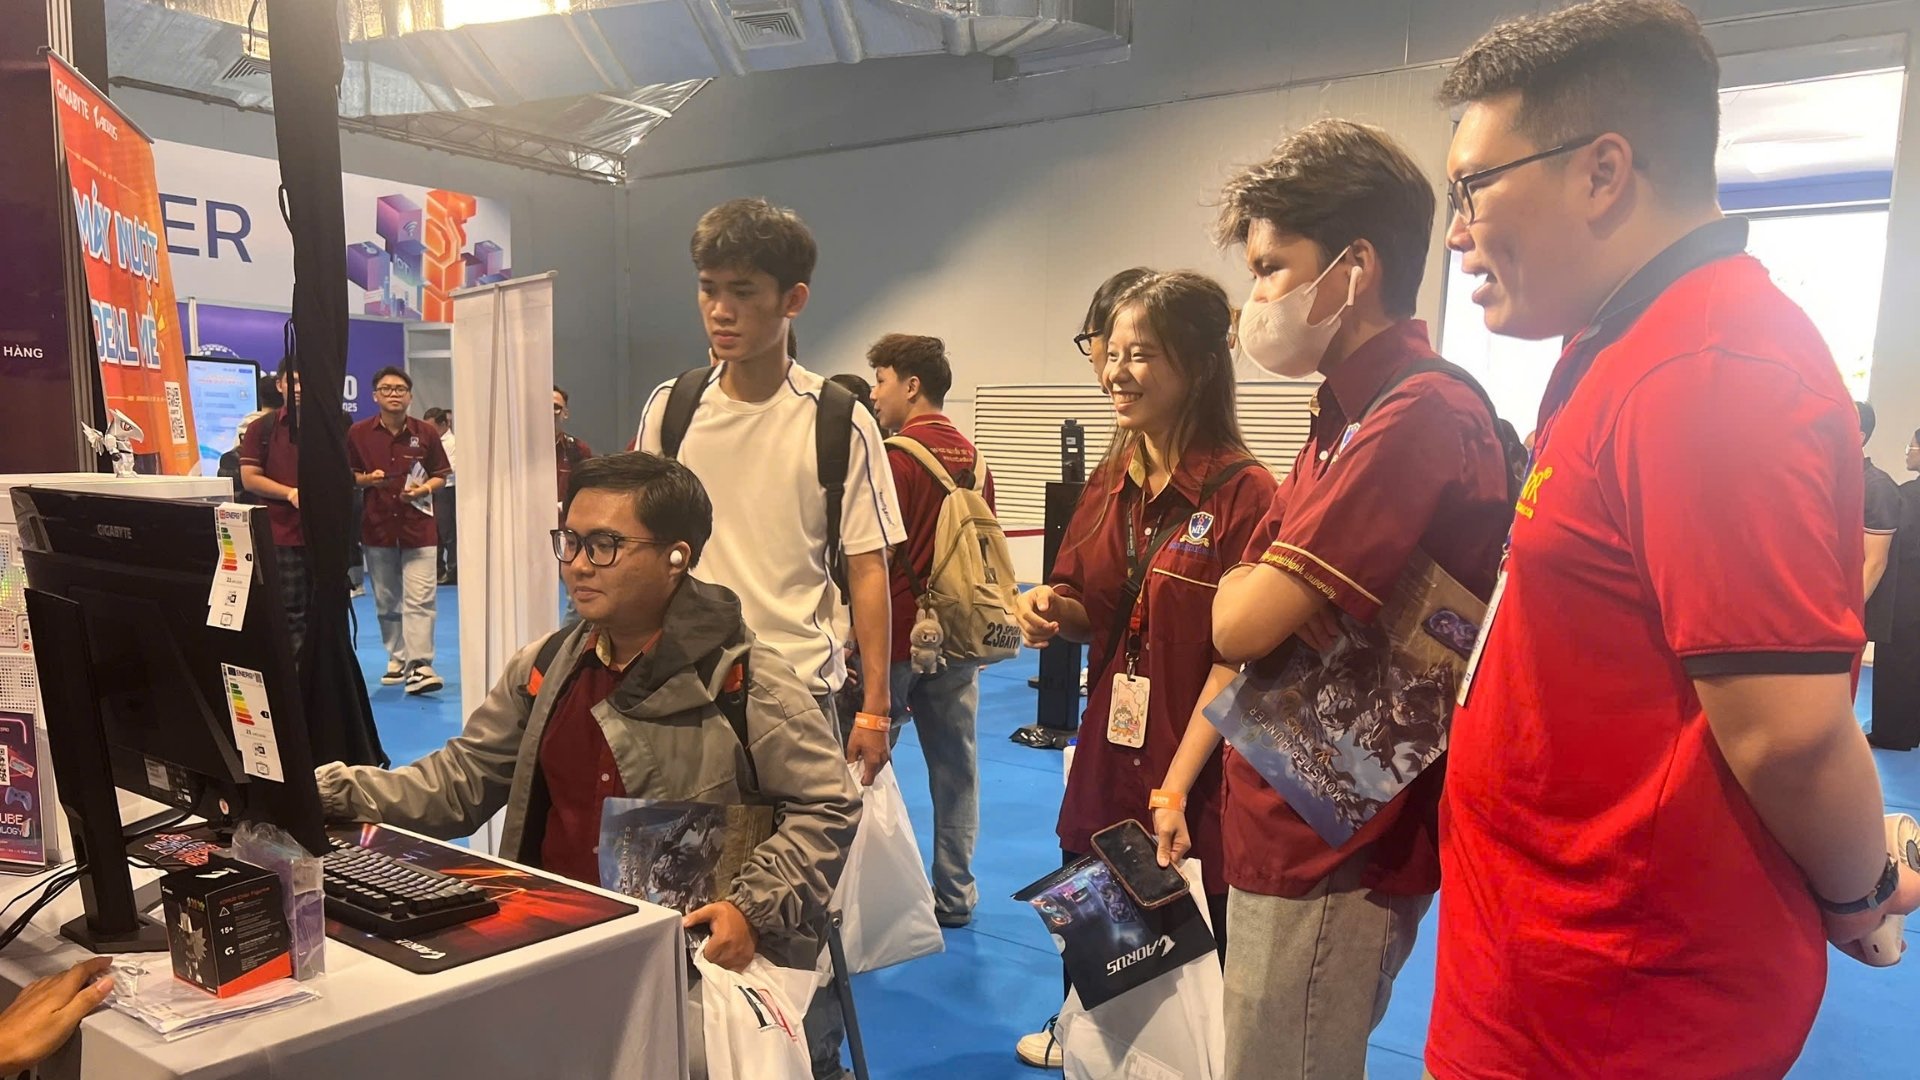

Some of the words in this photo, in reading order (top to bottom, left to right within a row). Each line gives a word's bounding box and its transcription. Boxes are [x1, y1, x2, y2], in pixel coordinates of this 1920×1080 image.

[56, 79, 89, 120] GIGABYTE
[91, 298, 140, 367] DEAL
[3, 344, 43, 359] HÀNG
[97, 524, 132, 540] GIGABYTE
[982, 621, 1003, 648] 23
[1248, 704, 1294, 752] HUNTER
[1291, 750, 1346, 802] MONSTER
[0, 826, 23, 836] LOGY
[220, 926, 234, 935] 15+
[1106, 937, 1166, 976] AORUS
